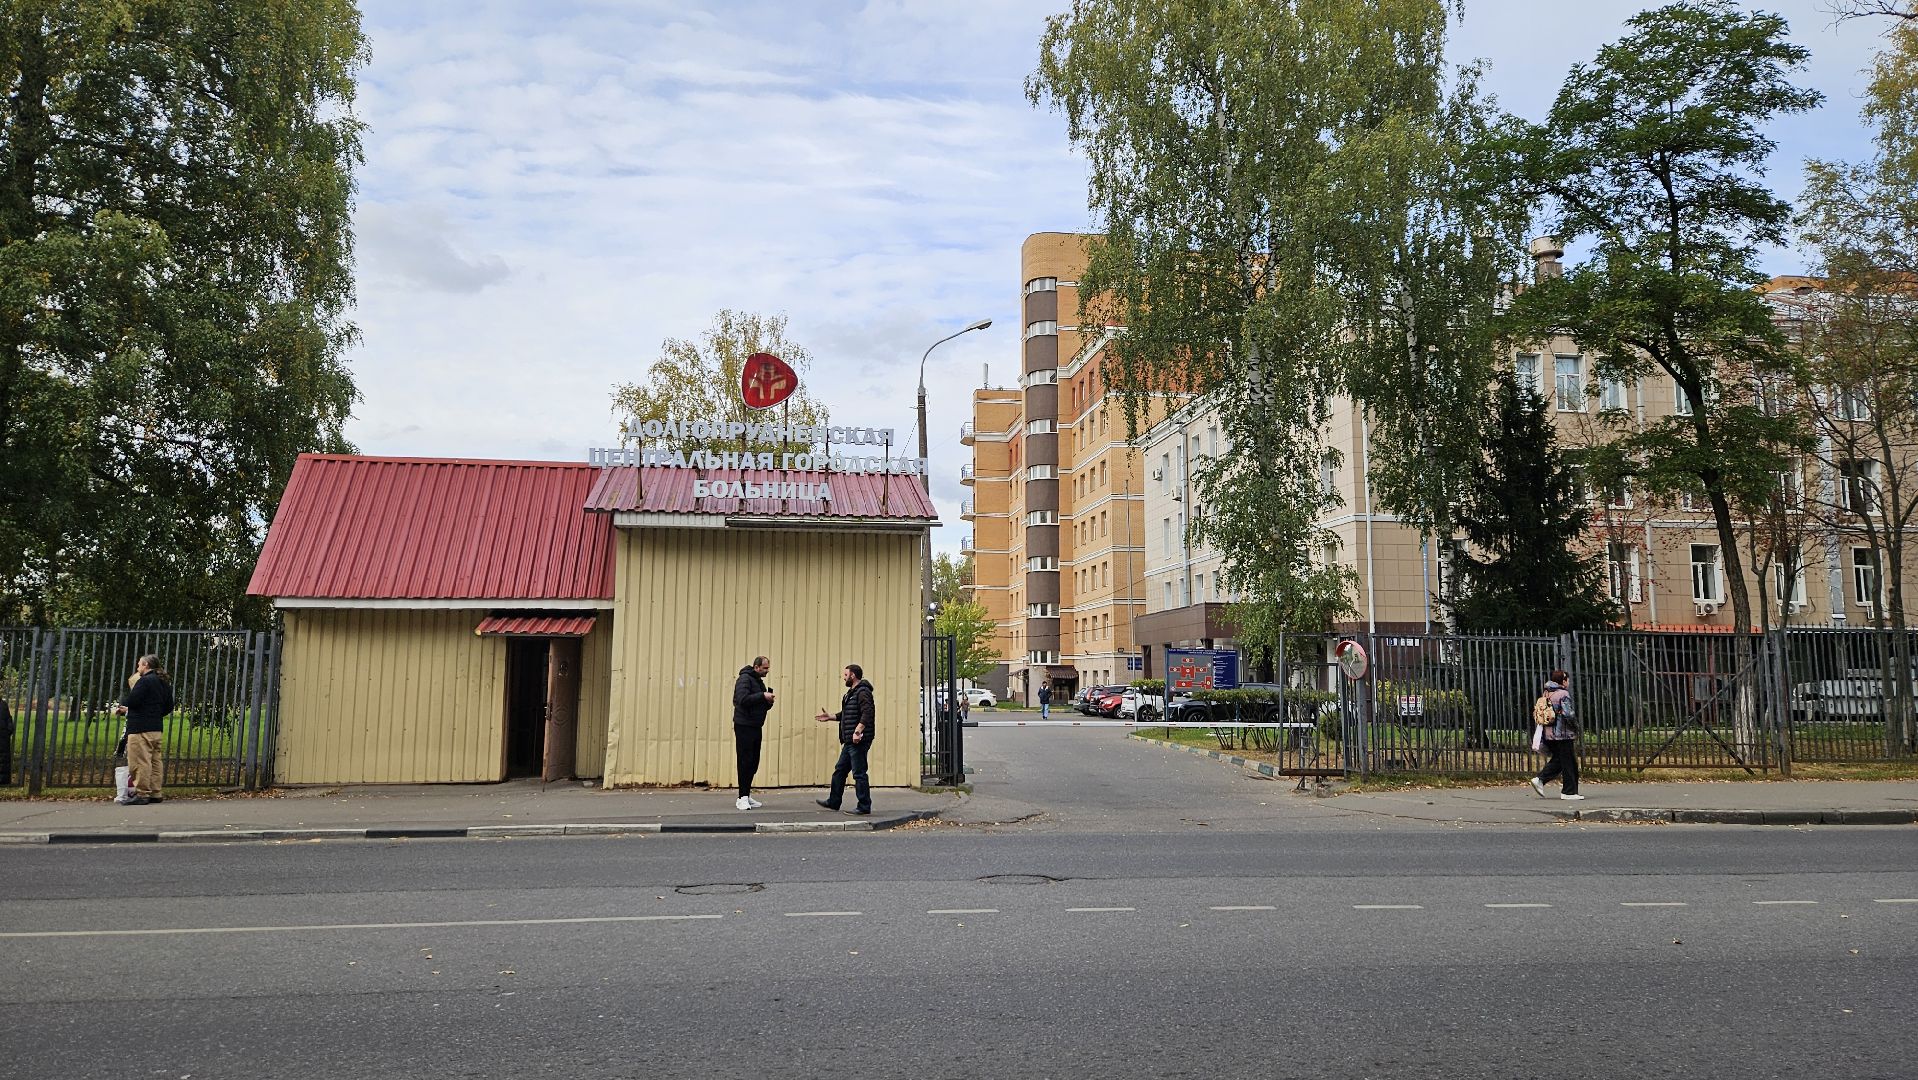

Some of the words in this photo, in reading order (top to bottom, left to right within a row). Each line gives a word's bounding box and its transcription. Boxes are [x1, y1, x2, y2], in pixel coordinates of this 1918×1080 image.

[626, 418, 895, 446] ДОЛГОПРУДНЕНСКАЯ
[588, 447, 774, 471] ЦЕНТРАЛЬНАЯ
[782, 452, 929, 477] ГОРОДСКАЯ
[693, 479, 833, 504] БОЛЬНИЦА
